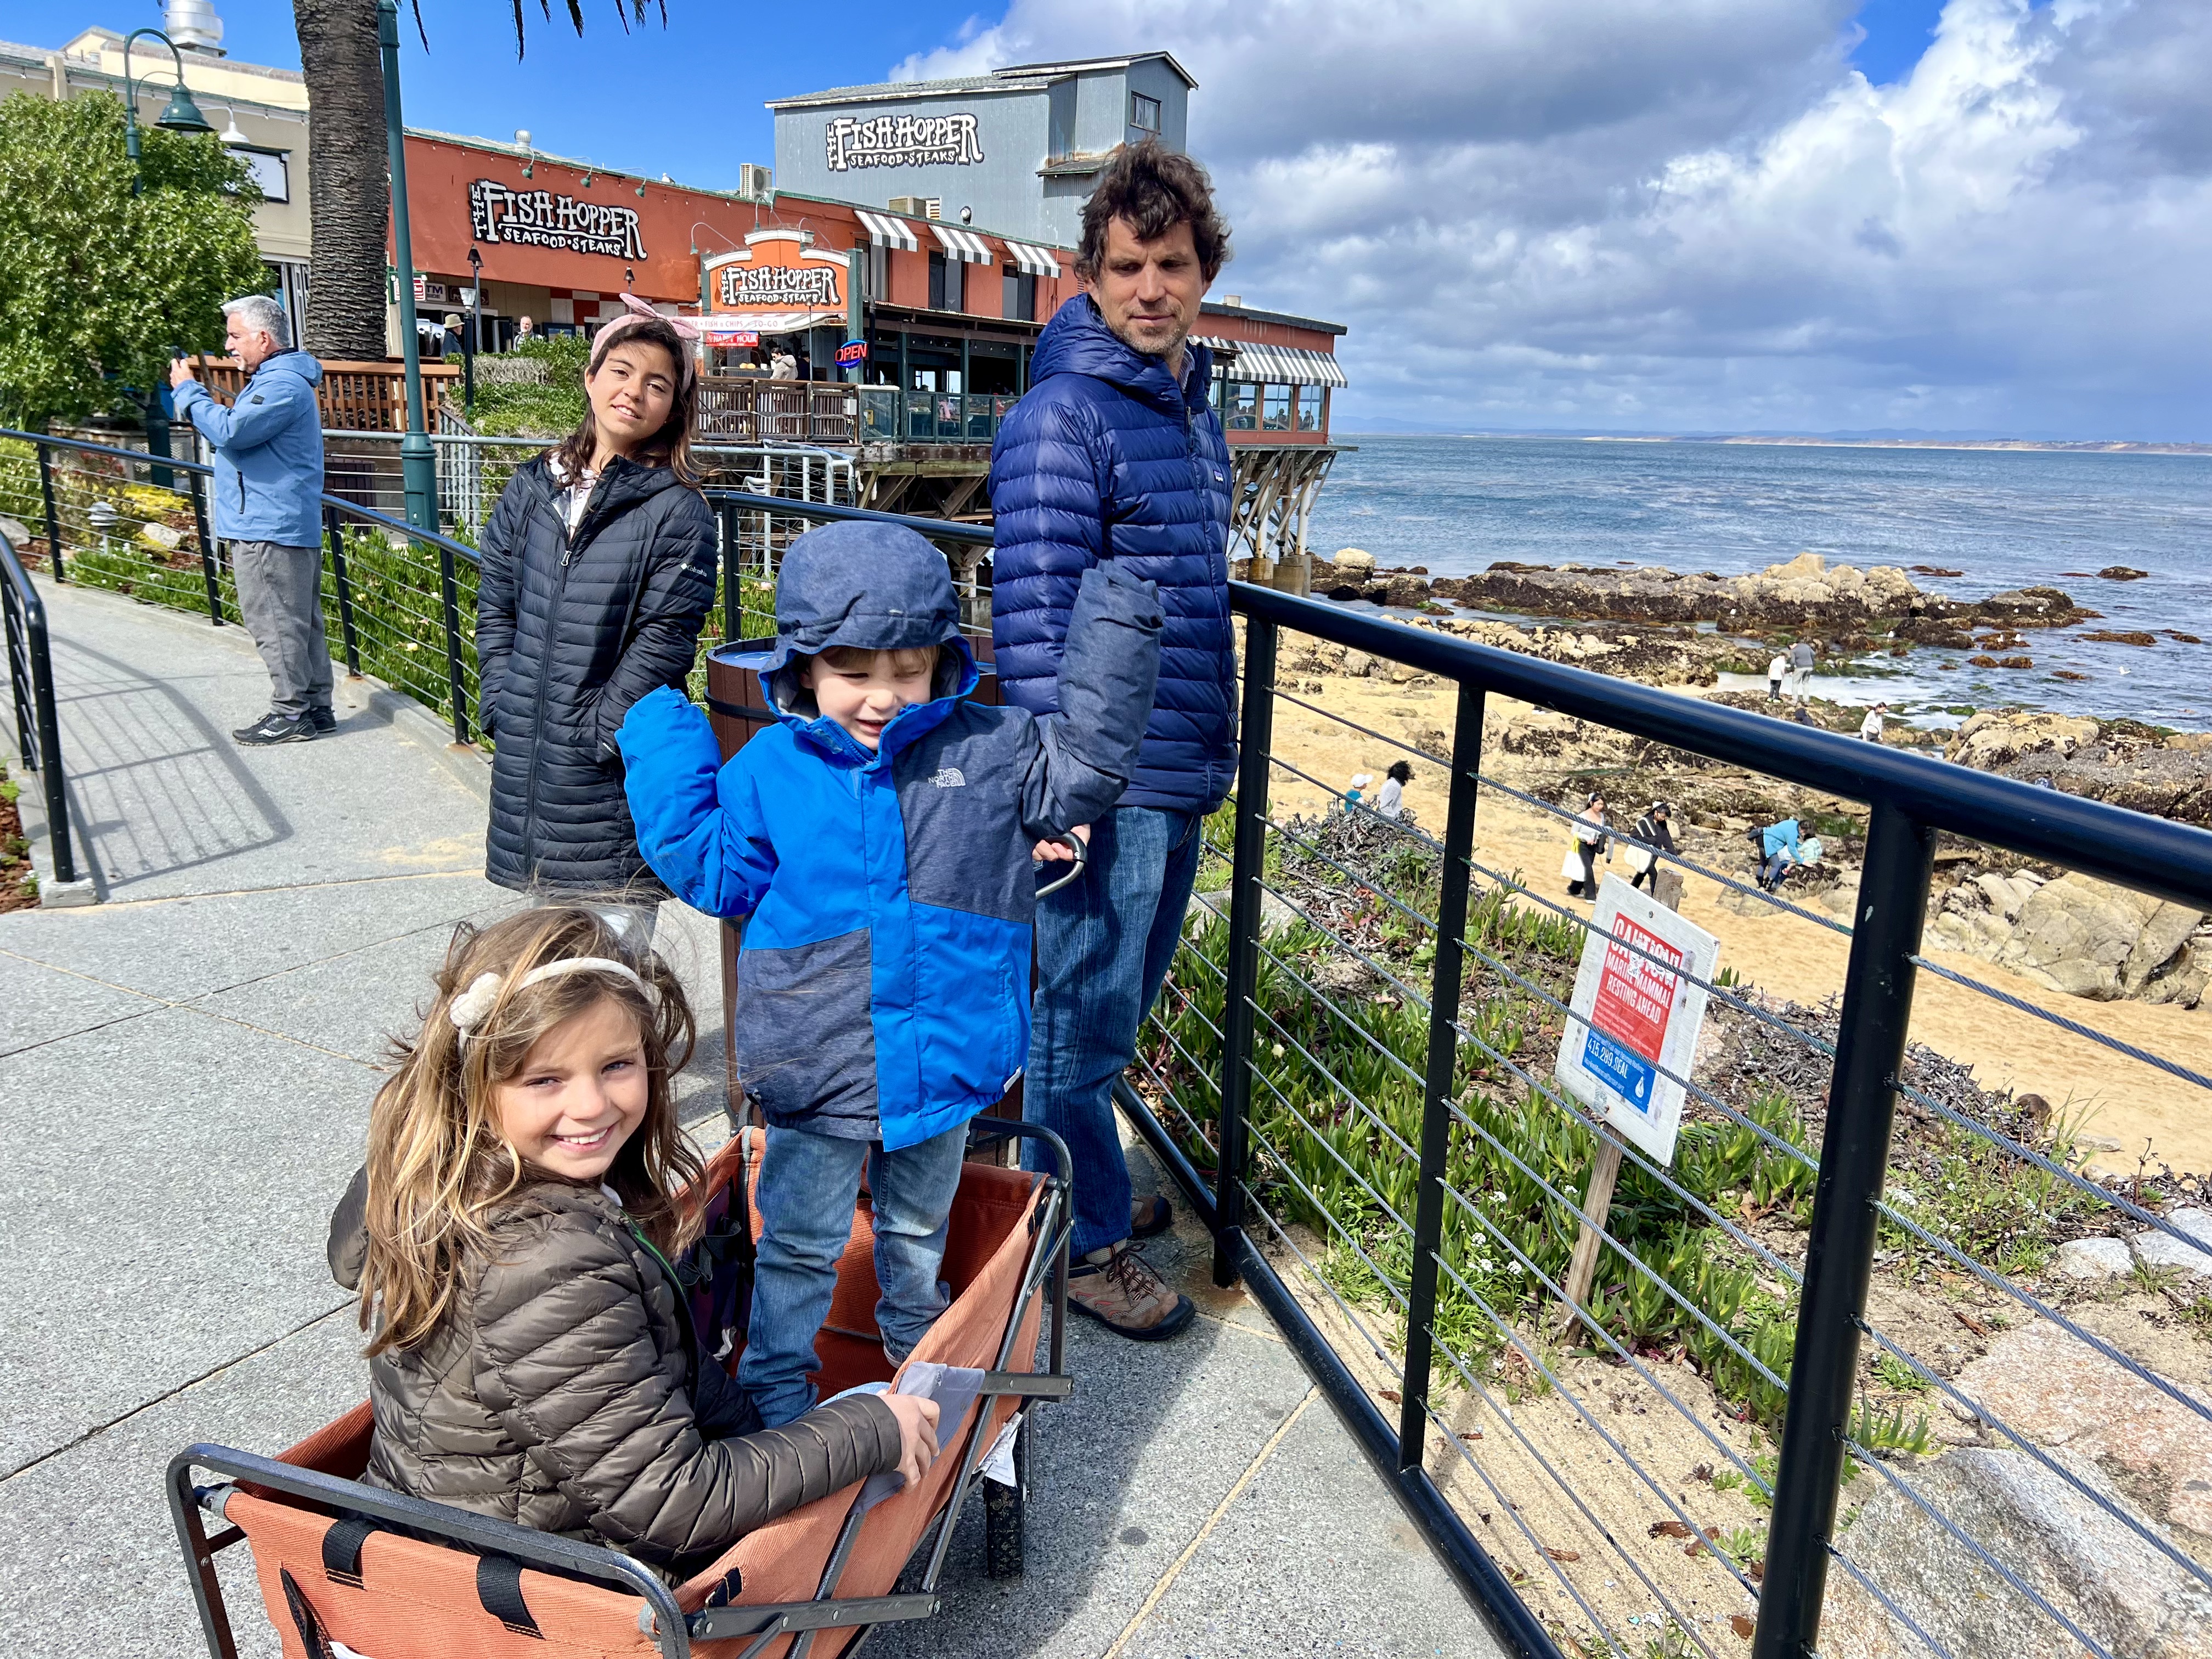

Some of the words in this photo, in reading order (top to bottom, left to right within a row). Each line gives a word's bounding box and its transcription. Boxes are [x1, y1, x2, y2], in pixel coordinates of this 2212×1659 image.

[826, 123, 838, 168] THE
[833, 116, 894, 169] FISH
[896, 113, 984, 163] HOPPER
[850, 151, 906, 167] SEAFOOD
[909, 150, 956, 164] STEAKS
[471, 184, 487, 239] THE
[480, 180, 554, 241] FISH
[556, 195, 648, 259] HOPPER
[503, 227, 566, 248] SEAFOOD
[571, 238, 621, 256] STEAKS
[426, 285, 443, 294] TM
[721, 270, 730, 303] THE
[726, 266, 771, 304] FISH
[772, 266, 838, 303] HOPPER
[738, 294, 779, 303] SEAFOOD
[713, 334, 736, 343] HAPPY
[737, 335, 757, 343] HOUR
[834, 343, 867, 362] OPEN
[687, 565, 707, 577] Columbia
[927, 775, 953, 784] NORTH
[936, 780, 955, 788] FACE
[1606, 974, 1638, 1007] RESTING
[1635, 994, 1662, 1025] AHEAD
[1633, 972, 1671, 1009] MAMMAL
[1587, 1037, 1628, 1079] 415.289.SEAL
